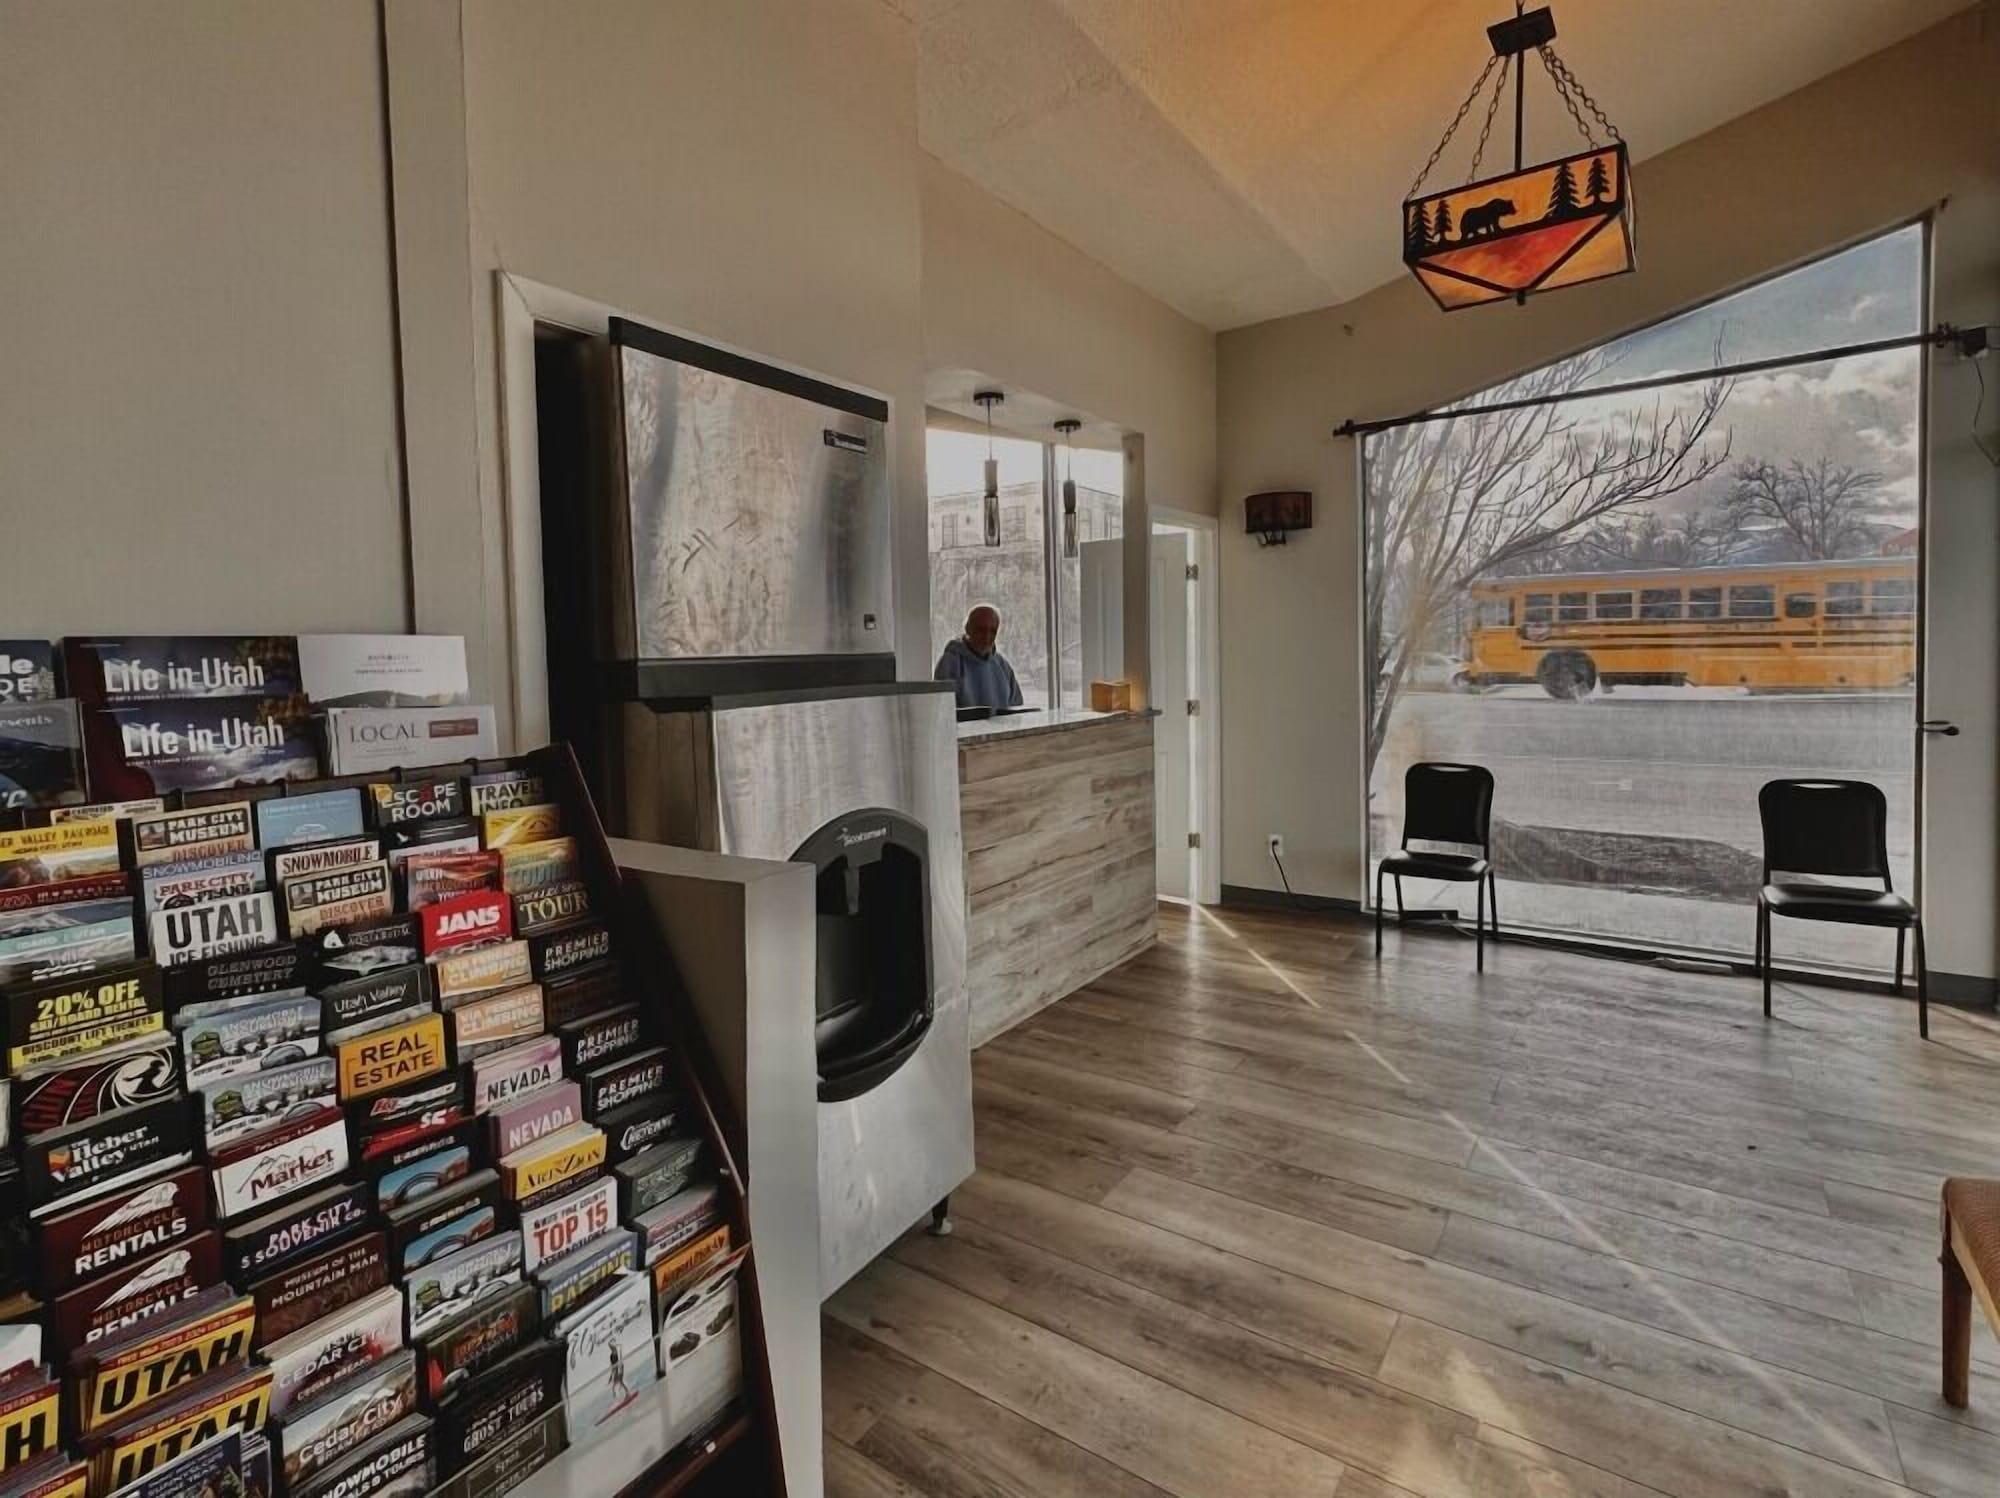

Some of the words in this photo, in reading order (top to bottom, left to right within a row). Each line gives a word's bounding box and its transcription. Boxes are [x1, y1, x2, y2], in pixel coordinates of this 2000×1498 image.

[103, 658, 160, 693] Life
[168, 661, 193, 691] in
[202, 656, 265, 690] Utah
[121, 722, 179, 758] Life
[187, 723, 215, 753] in
[221, 715, 285, 752] Utah
[350, 722, 421, 744] LOCAL
[168, 814, 207, 830] PARK
[210, 809, 245, 825] CITY
[392, 797, 453, 823] ROOM
[21, 830, 57, 845] VALLEY
[168, 821, 246, 842] MUSEUM
[172, 838, 249, 861] DISCOVER
[282, 844, 373, 875] SNOWMOBILE
[158, 877, 207, 898] PARK
[207, 871, 255, 890] CITY
[315, 874, 352, 891] PARK
[354, 868, 382, 884] CITY
[316, 879, 383, 904] MUSEUM
[166, 899, 264, 949] UTAH
[435, 904, 504, 937] JANS
[520, 890, 593, 925] TOUR
[200, 935, 266, 961] FISHING
[544, 943, 609, 973] SHOPPING
[545, 931, 609, 960] PREMIER
[207, 955, 297, 978] GLENWOOD
[37, 991, 95, 1021] 20%
[98, 979, 141, 1007] OFF
[334, 994, 367, 1014] Utah
[22, 1033, 83, 1057] DISCOUNT
[360, 1032, 428, 1067] REAL
[576, 1033, 639, 1066] SHOPPING
[577, 1018, 640, 1053] PREMIER
[353, 1050, 435, 1090] ESTATE
[487, 1063, 553, 1103] NEVADA
[598, 1065, 665, 1099] PREMIER
[508, 1106, 574, 1150] NEVADA
[250, 1149, 335, 1200] Market
[75, 1217, 188, 1276] RENTALS
[81, 1206, 182, 1254] MOTORCYCLE
[533, 1213, 580, 1259] TOP
[585, 1199, 610, 1234] 15
[271, 1265, 346, 1310] MOUNTAIN
[348, 1252, 380, 1278] MAN
[93, 1274, 194, 1325] MOTORCYCLE
[100, 1329, 245, 1416] UTAH
[280, 1348, 343, 1389] CEDAR
[299, 1420, 360, 1466] Cedar
[361, 1391, 405, 1429] City
[463, 1416, 503, 1454] GHOST
[507, 1386, 545, 1423] TOURS
[118, 1396, 262, 1491] UTAH
